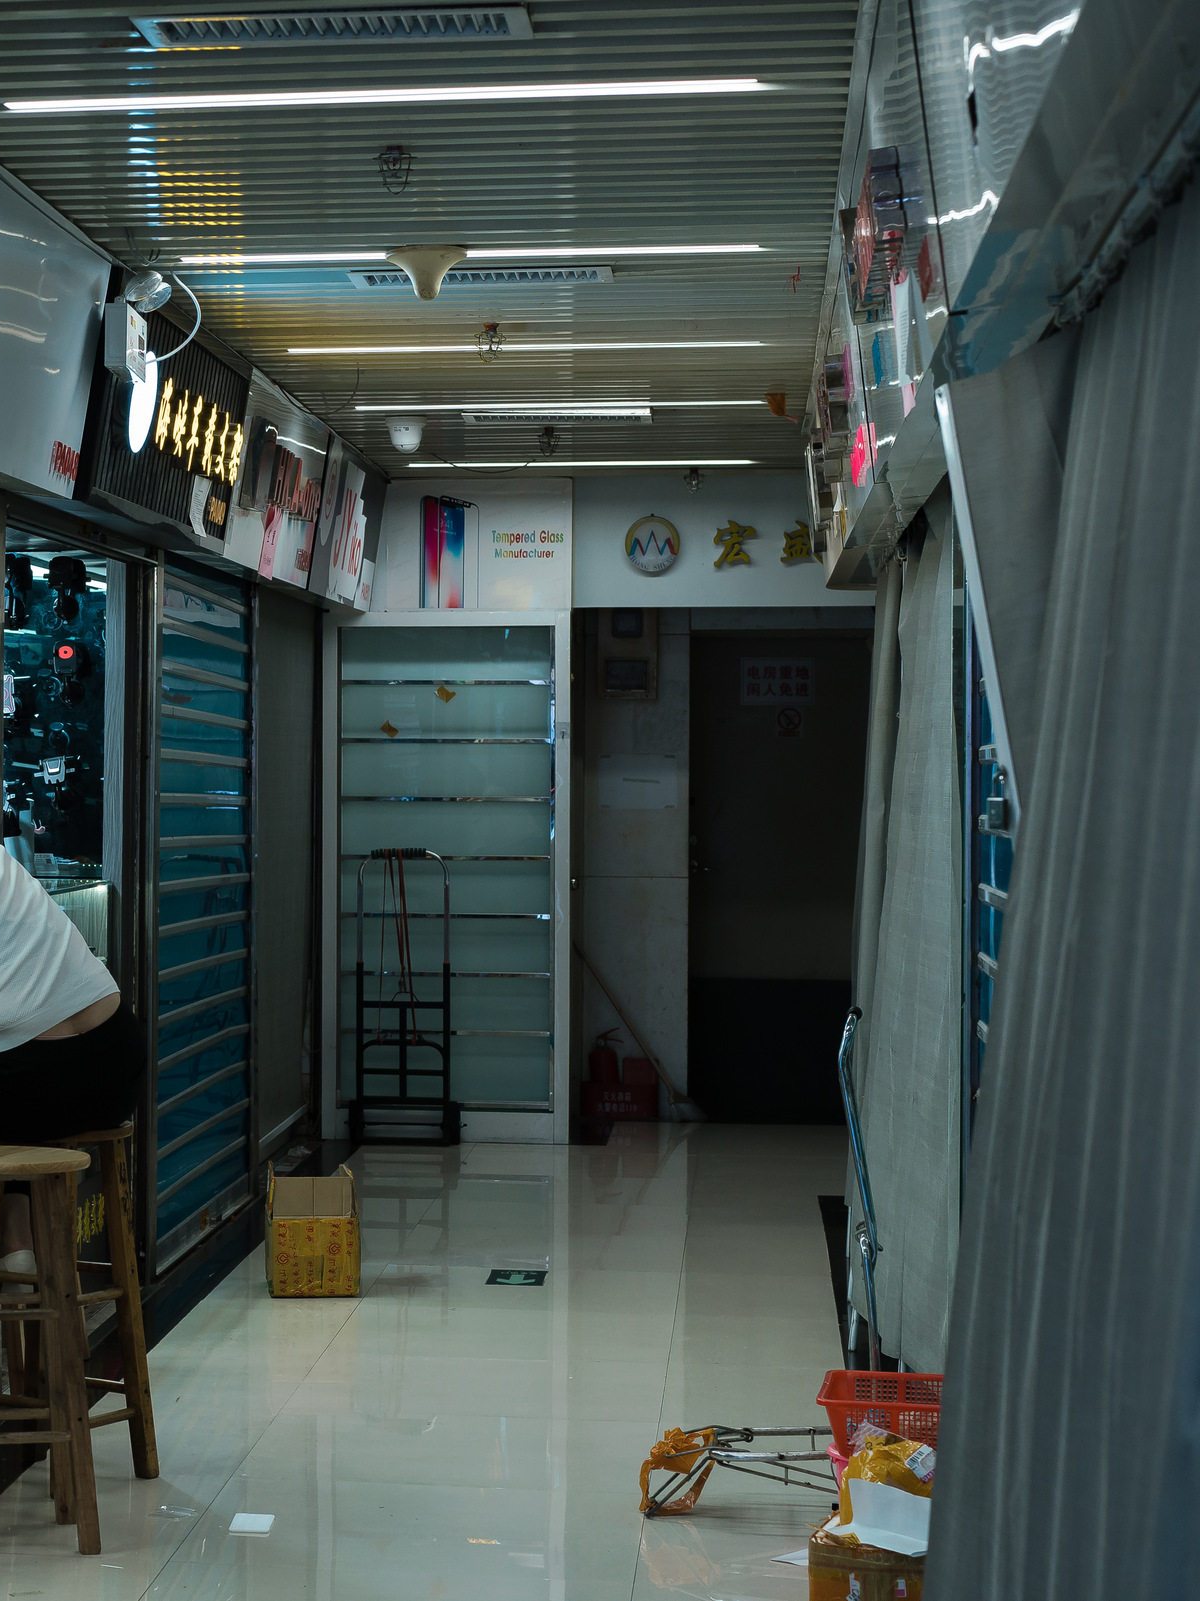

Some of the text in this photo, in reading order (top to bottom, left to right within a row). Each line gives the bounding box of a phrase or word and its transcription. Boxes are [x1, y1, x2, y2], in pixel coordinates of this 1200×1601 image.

[53, 441, 80, 481] PA048
[491, 530, 564, 546] Tempered Glass
[494, 548, 555, 559] Manufacturer
[747, 665, 810, 680] 电房重地
[747, 682, 809, 697] 闲人免进
